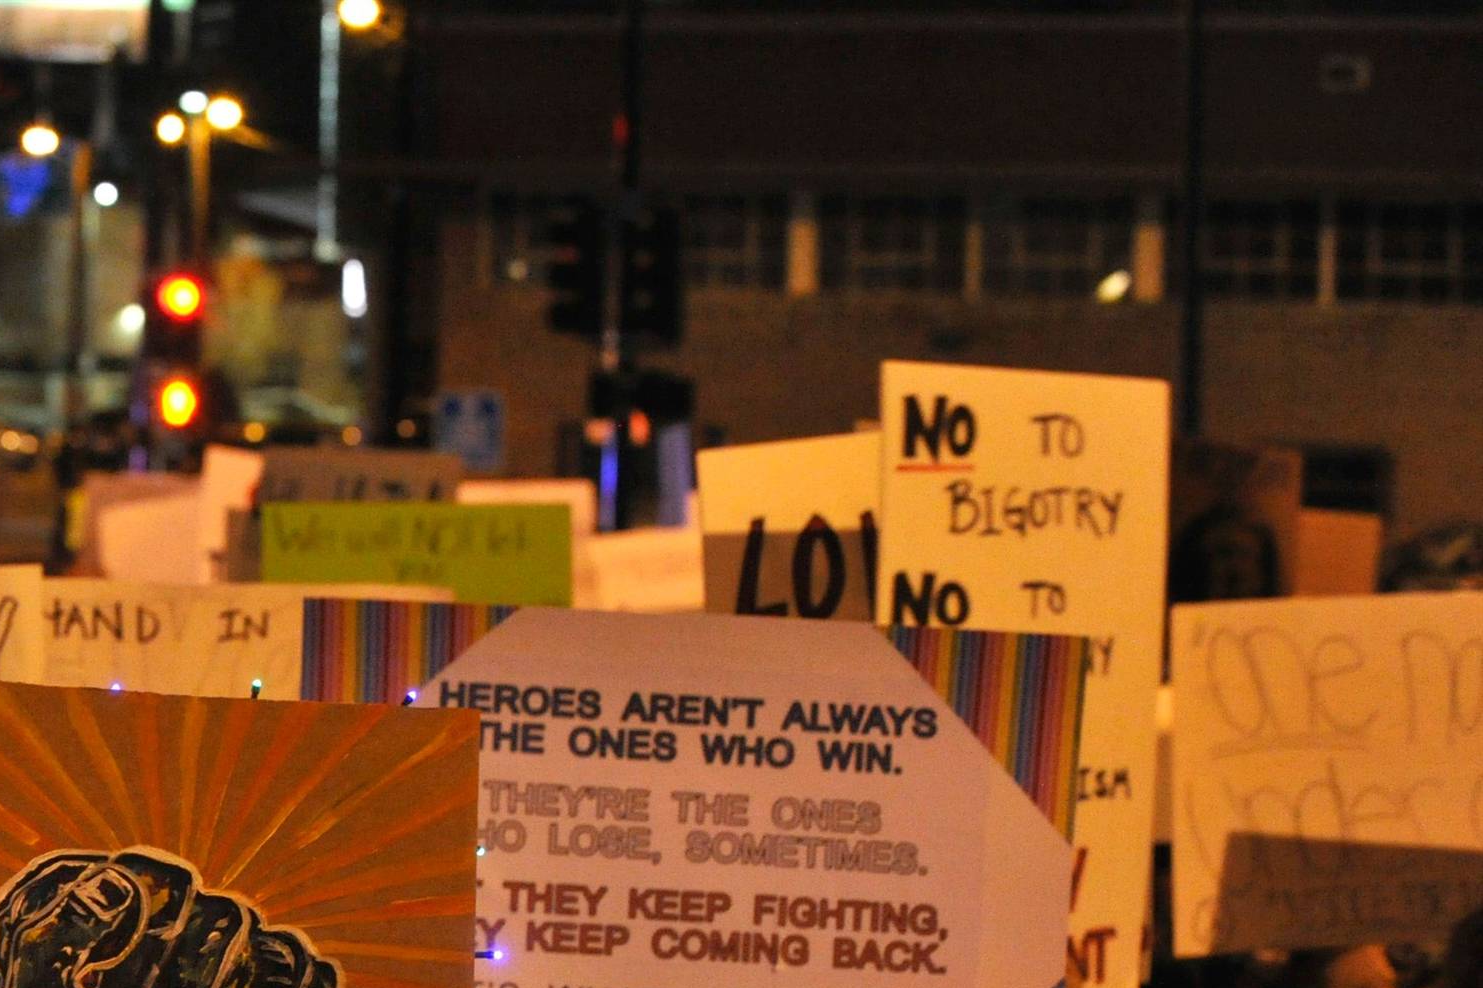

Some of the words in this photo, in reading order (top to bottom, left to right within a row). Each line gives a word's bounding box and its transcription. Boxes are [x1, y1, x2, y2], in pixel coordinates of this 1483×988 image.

[902, 396, 977, 462] NO
[1031, 412, 1084, 457] TO
[946, 480, 1124, 538] BIGOTRY
[218, 608, 271, 643] IN
[892, 572, 970, 626] NO
[1020, 580, 1066, 620] TO
[440, 680, 602, 720] HEROES
[621, 691, 765, 730] AREN'T
[781, 700, 938, 739] ALWAYS
[480, 720, 546, 756] THE
[568, 726, 677, 763] ONES
[700, 733, 795, 770] WHO
[818, 739, 903, 776] WIN.
[482, 779, 651, 822] THEY'RE
[670, 790, 750, 827] THE
[771, 796, 883, 836] ONES
[548, 822, 662, 866] LOSE,
[684, 829, 928, 877] SOMETIMES.
[503, 880, 608, 917] THEY
[628, 888, 732, 923] KEEP
[753, 893, 948, 941] FIGHTING,
[475, 917, 506, 951] Y
[526, 920, 631, 956] KEEP
[650, 927, 810, 967] COMING
[832, 936, 947, 975] BACK.
